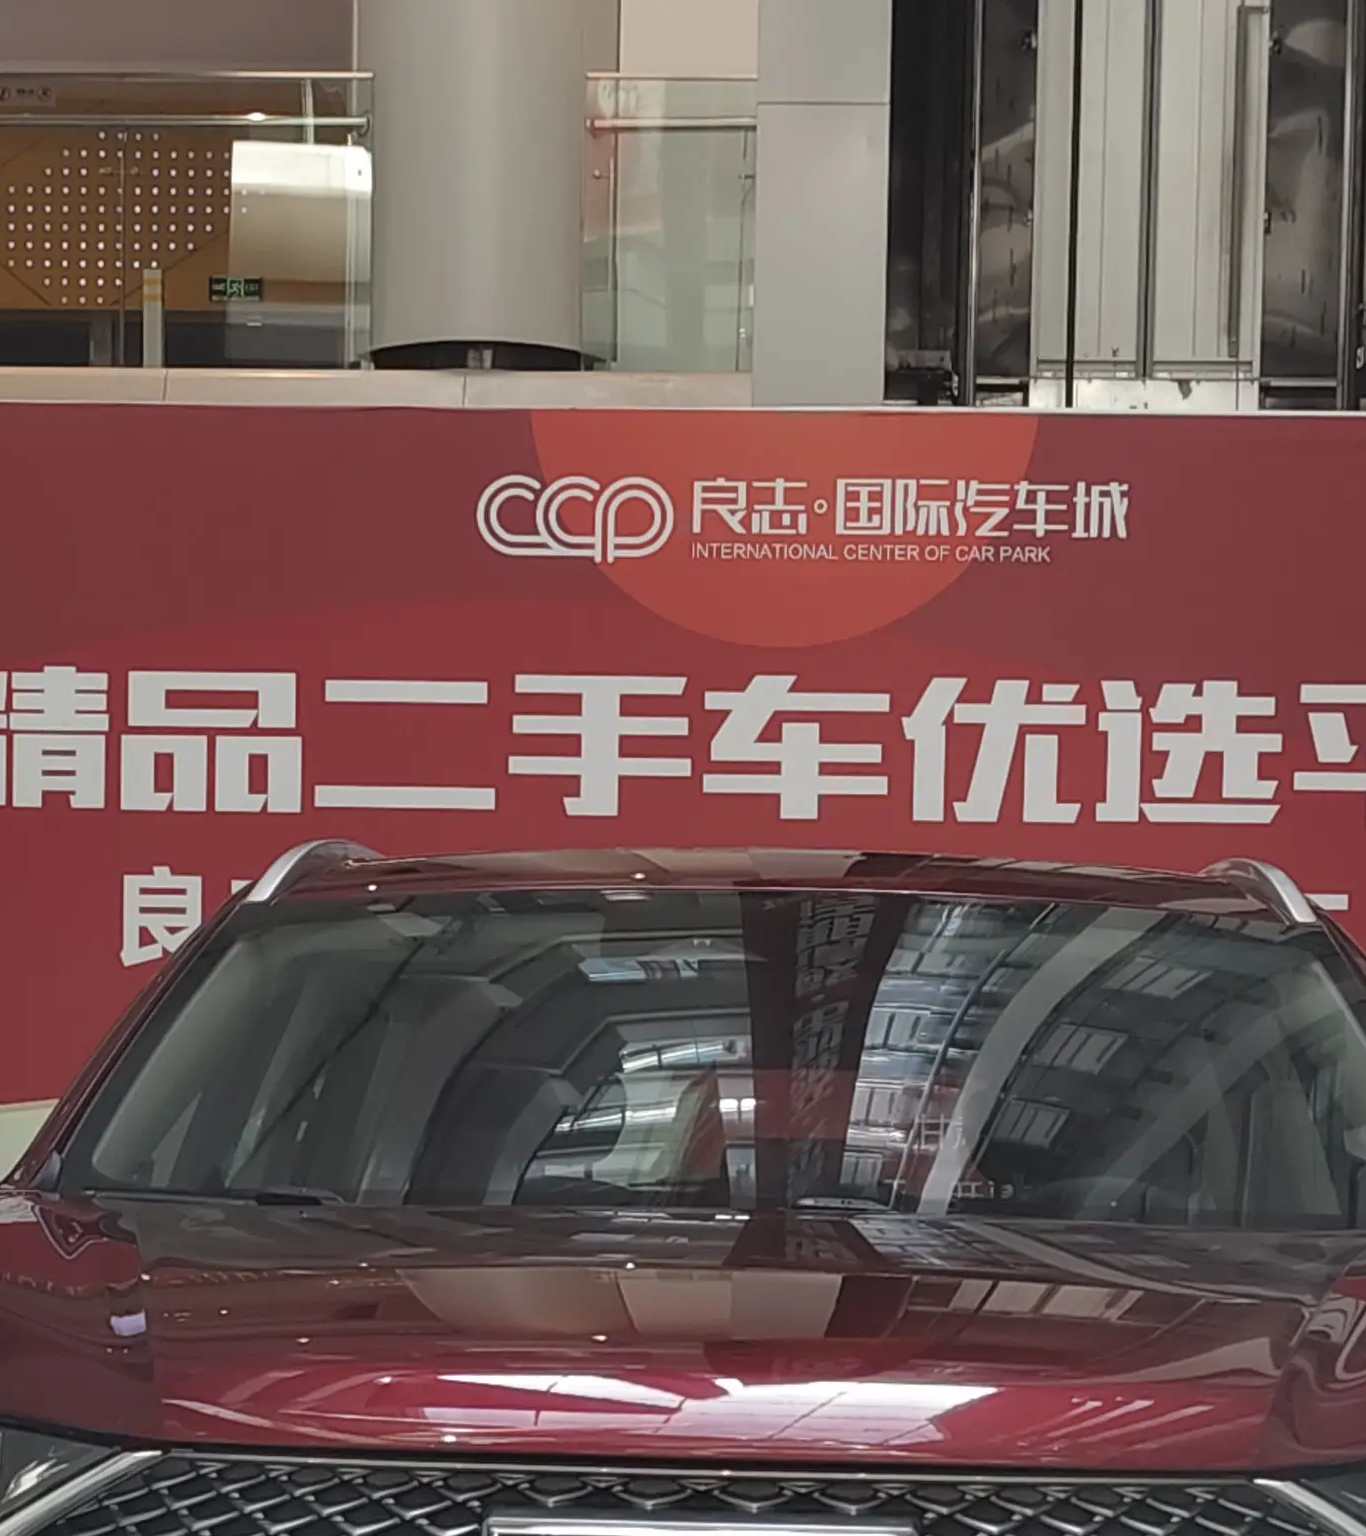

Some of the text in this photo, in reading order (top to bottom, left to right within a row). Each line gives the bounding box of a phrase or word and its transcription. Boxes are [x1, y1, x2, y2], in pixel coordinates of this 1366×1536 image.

[691, 542, 1051, 563] INTERNATIONAL CENTER OF CAR PARK
